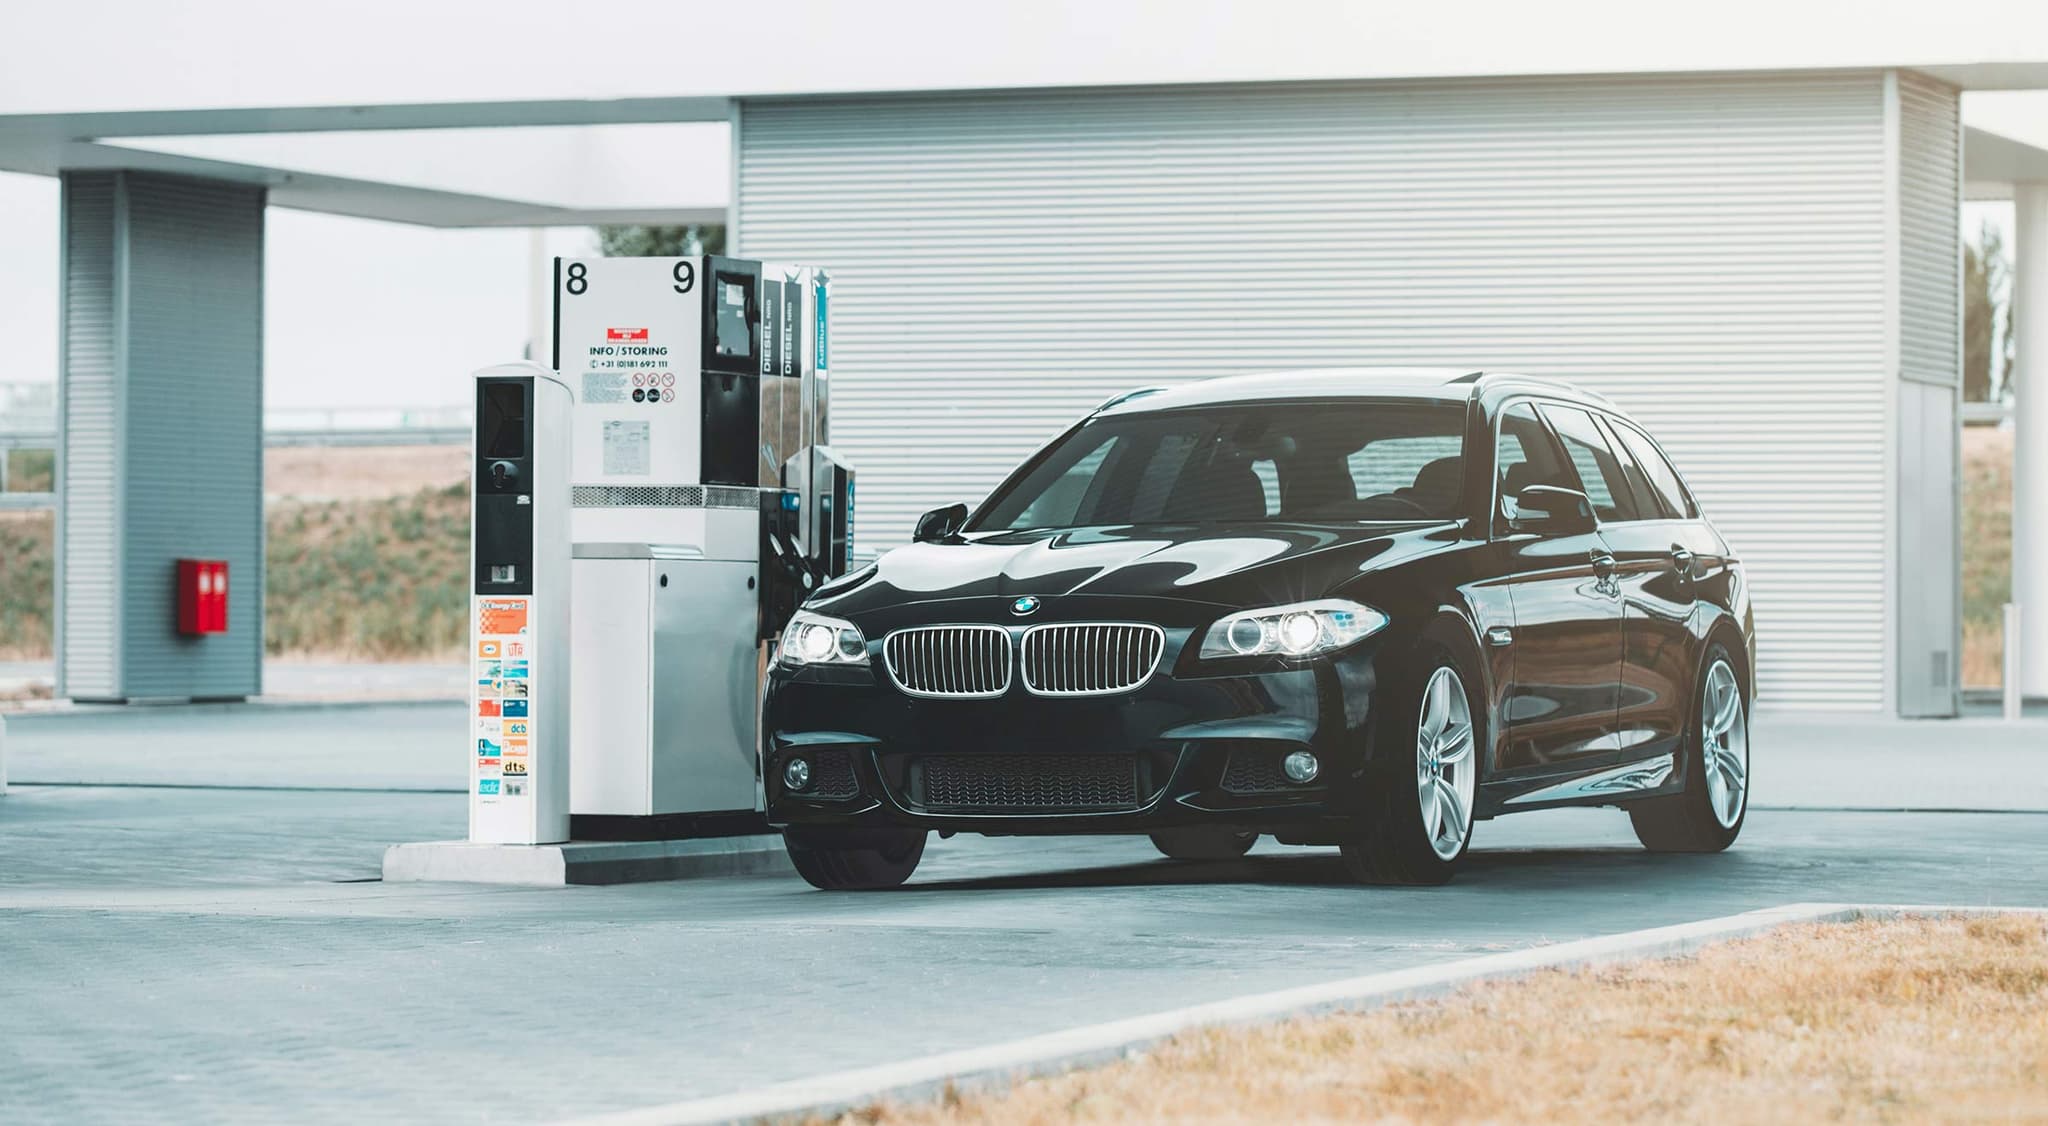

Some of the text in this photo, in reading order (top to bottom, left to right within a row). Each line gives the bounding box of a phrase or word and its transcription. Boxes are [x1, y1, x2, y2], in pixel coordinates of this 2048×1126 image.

[566, 262, 588, 295] 8
[673, 260, 695, 294] 9
[763, 321, 772, 372] DIESEL
[784, 323, 793, 374] DIESEL
[504, 761, 526, 772] dts
